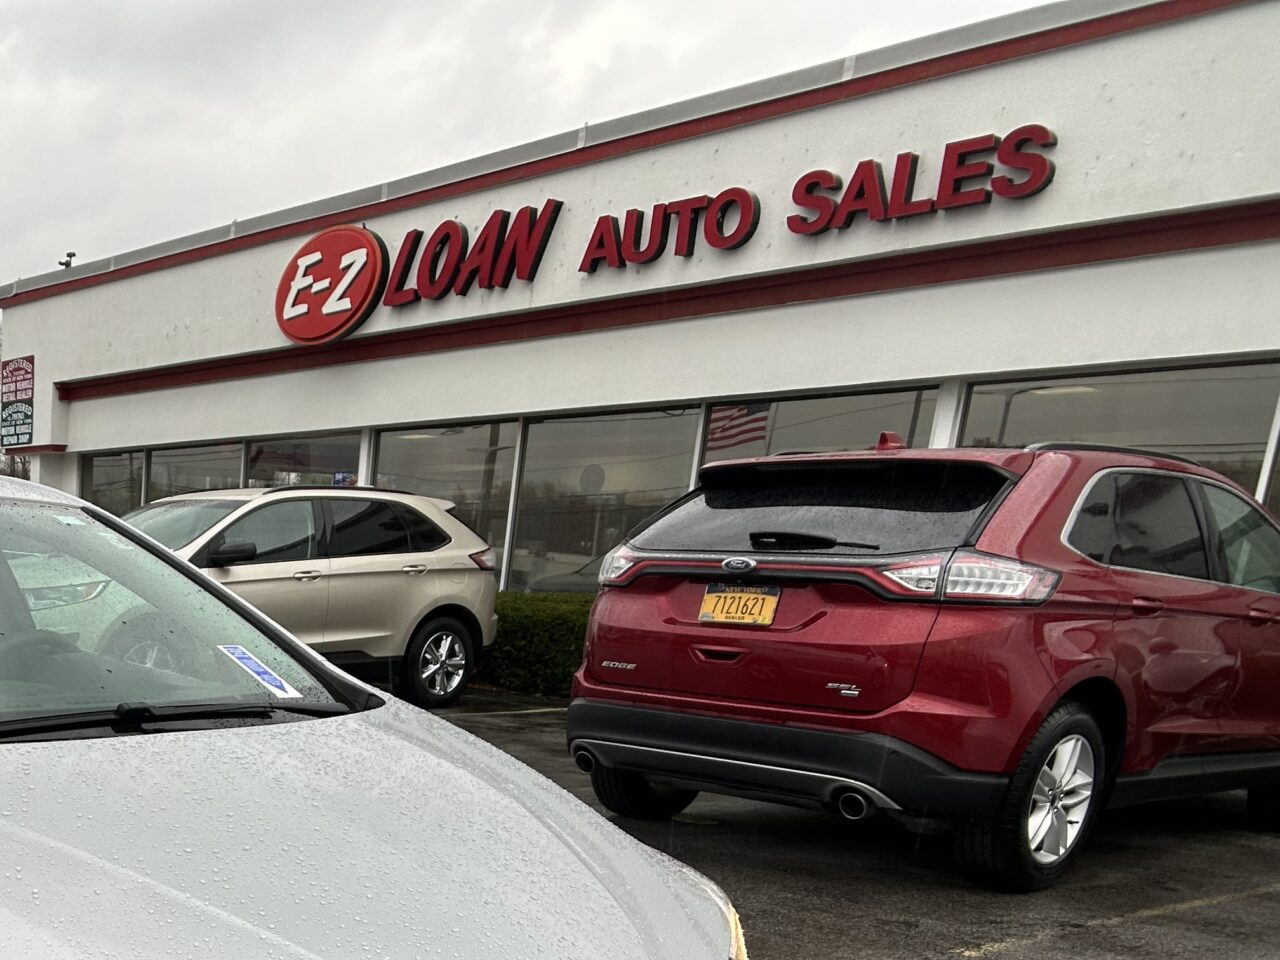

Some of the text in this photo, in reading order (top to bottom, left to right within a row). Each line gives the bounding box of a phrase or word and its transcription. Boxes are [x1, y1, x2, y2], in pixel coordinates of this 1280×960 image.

[282, 123, 1058, 320] E-Z LOAN AUTO SALES
[3, 358, 33, 377] REGISTERED
[2, 402, 33, 420] REGISTERED
[18, 433, 30, 443] SHOP
[728, 560, 747, 569] Ford
[711, 595, 766, 617] 7121621
[601, 660, 637, 670] EDGE
